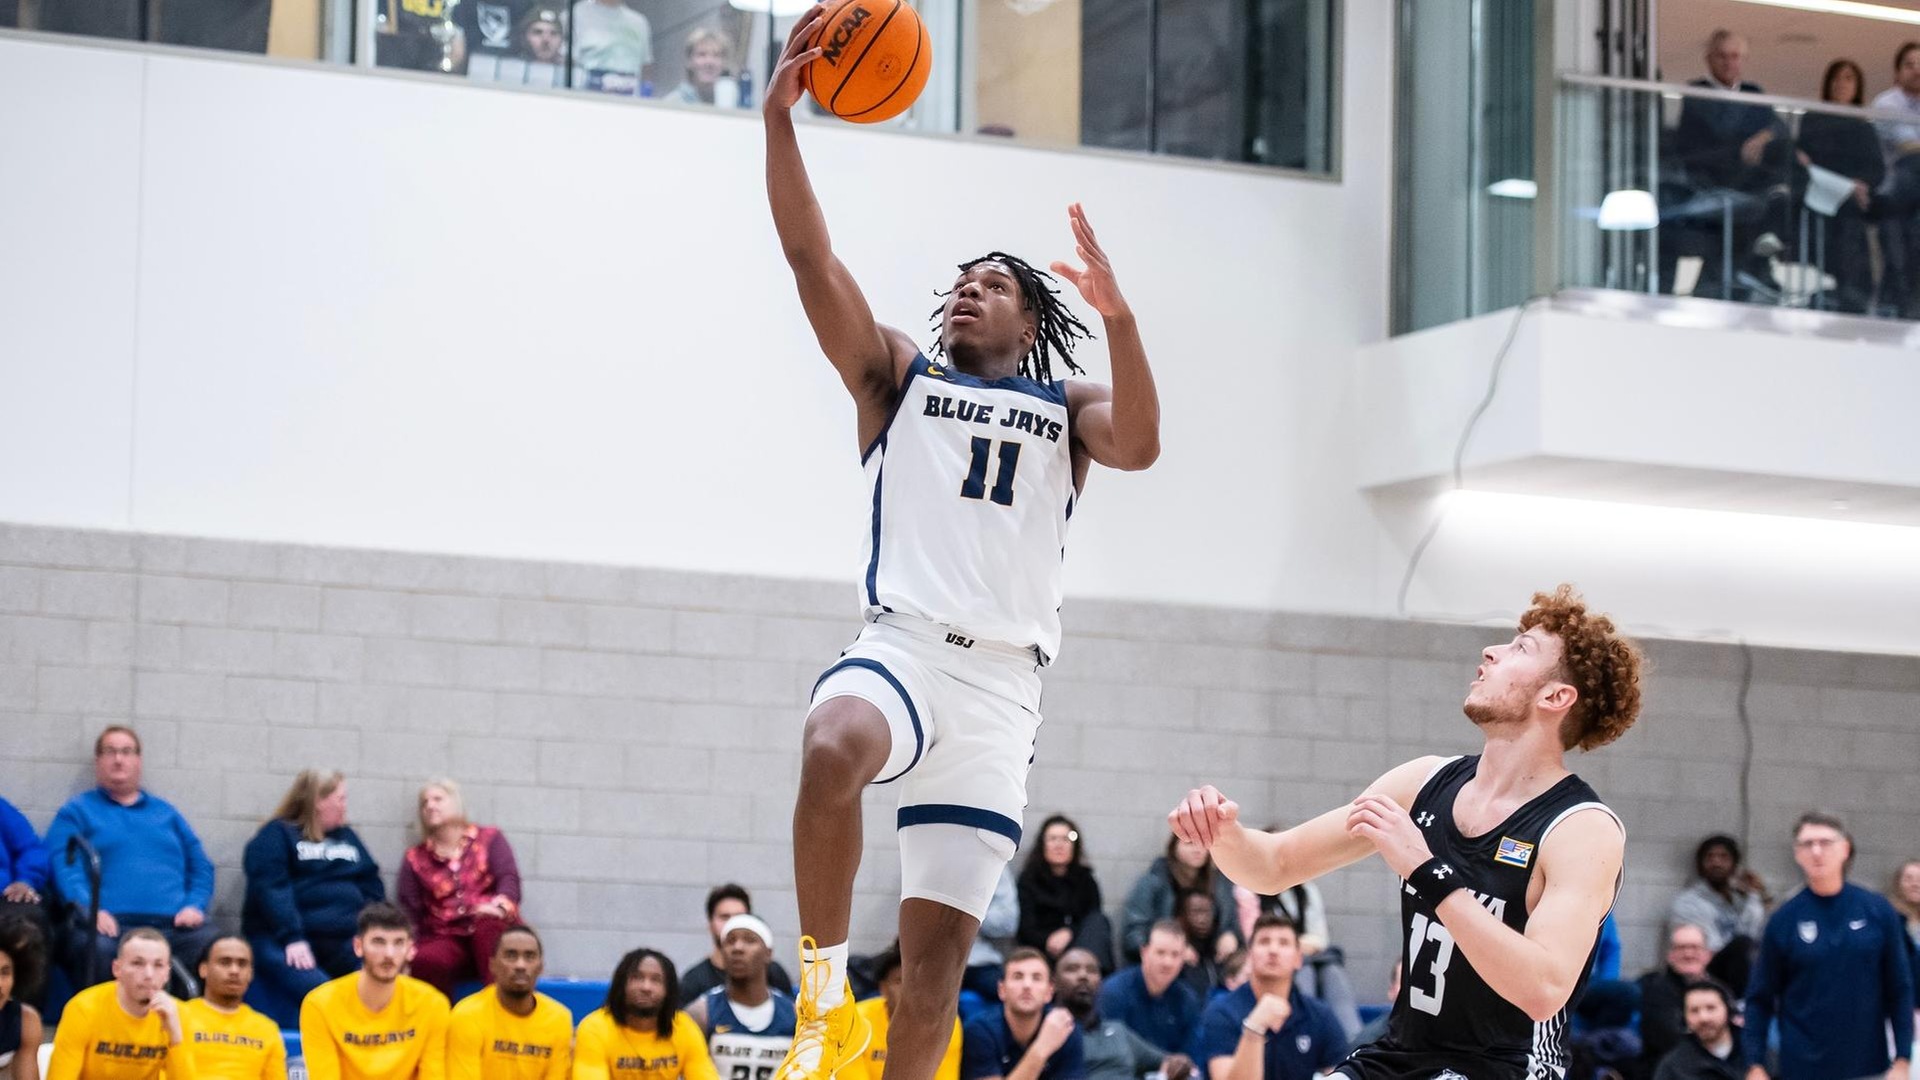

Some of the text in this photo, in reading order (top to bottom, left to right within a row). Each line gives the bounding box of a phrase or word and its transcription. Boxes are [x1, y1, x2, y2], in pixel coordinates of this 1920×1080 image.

[822, 7, 872, 67] NCAA
[923, 395, 1063, 443] BLUE JAYS
[960, 435, 1022, 506] 11
[945, 632, 975, 649] USJ
[1409, 912, 1456, 1017] 13
